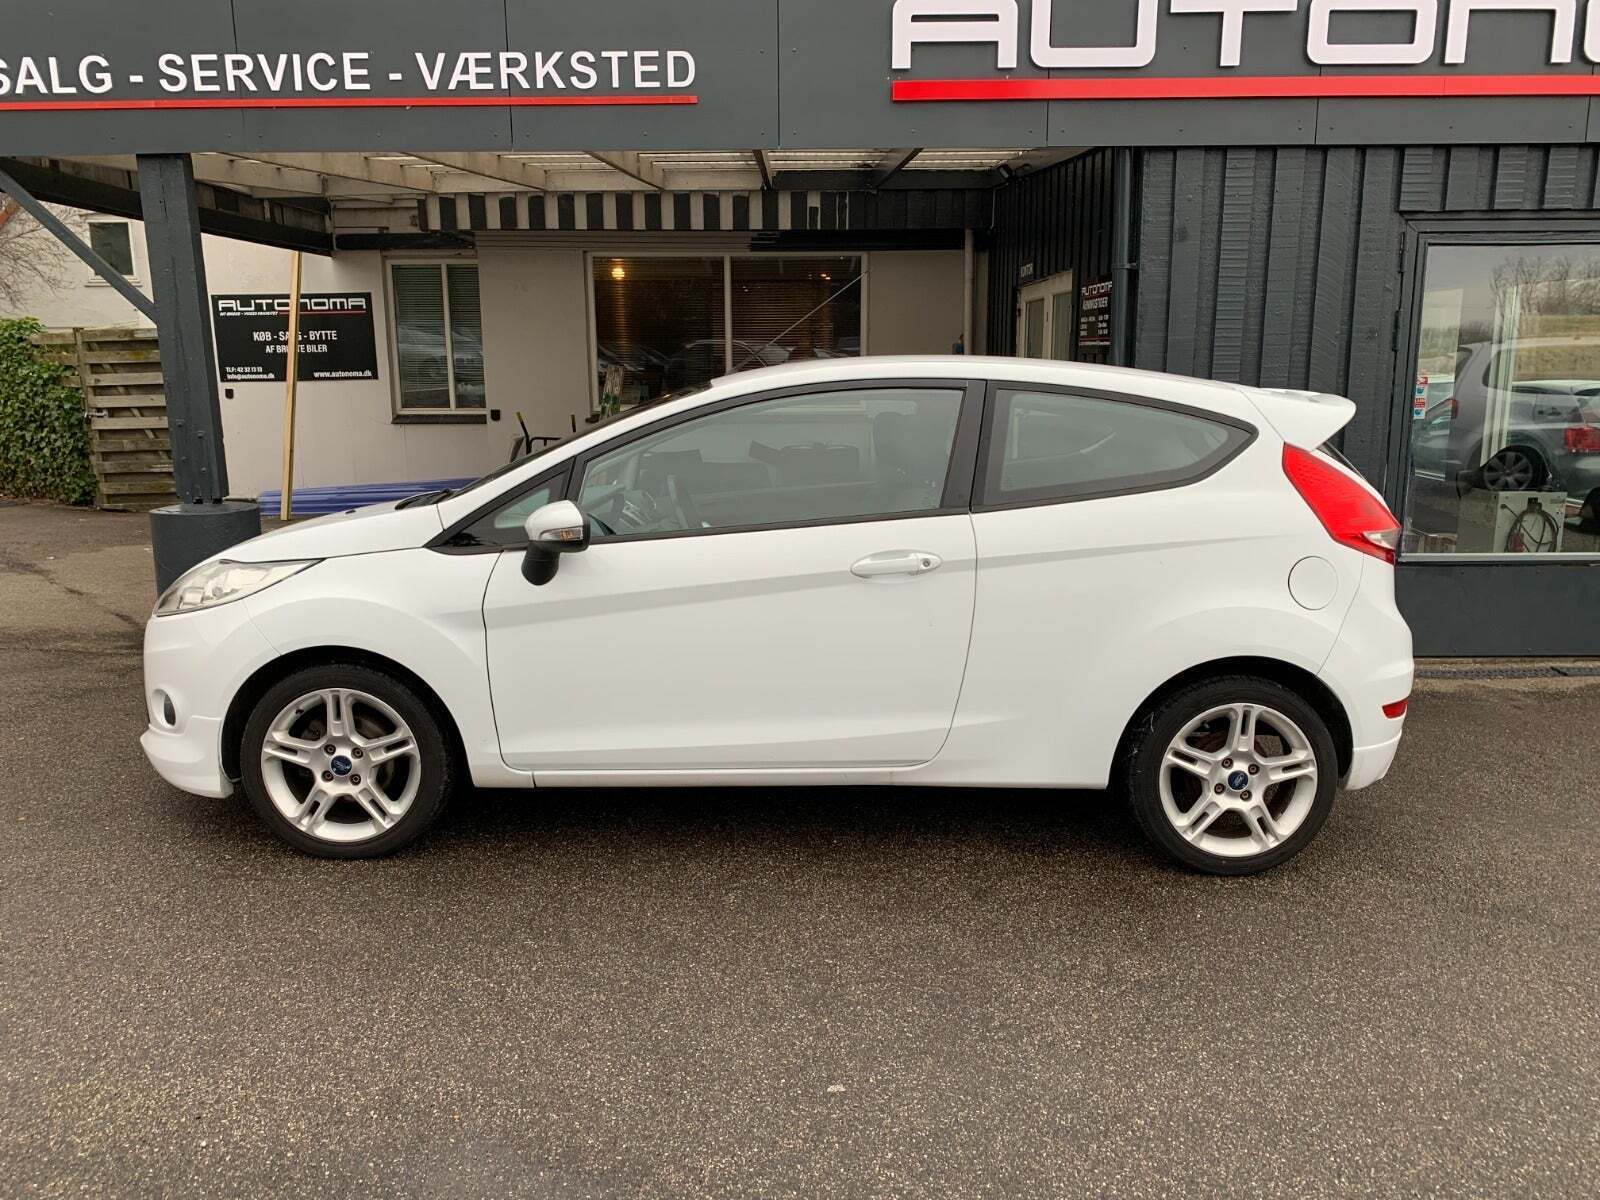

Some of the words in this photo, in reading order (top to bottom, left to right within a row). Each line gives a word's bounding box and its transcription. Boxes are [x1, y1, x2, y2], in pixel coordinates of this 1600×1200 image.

[891, 0, 1600, 70] AUTON
[158, 51, 371, 92] SERVICE
[414, 49, 696, 90] VÆRKSTED
[252, 331, 272, 342] KØB
[278, 330, 303, 342] SAG
[308, 330, 338, 341] BYTTE
[265, 344, 275, 354] AF
[276, 343, 306, 354] BRTE
[306, 343, 328, 353] BILER
